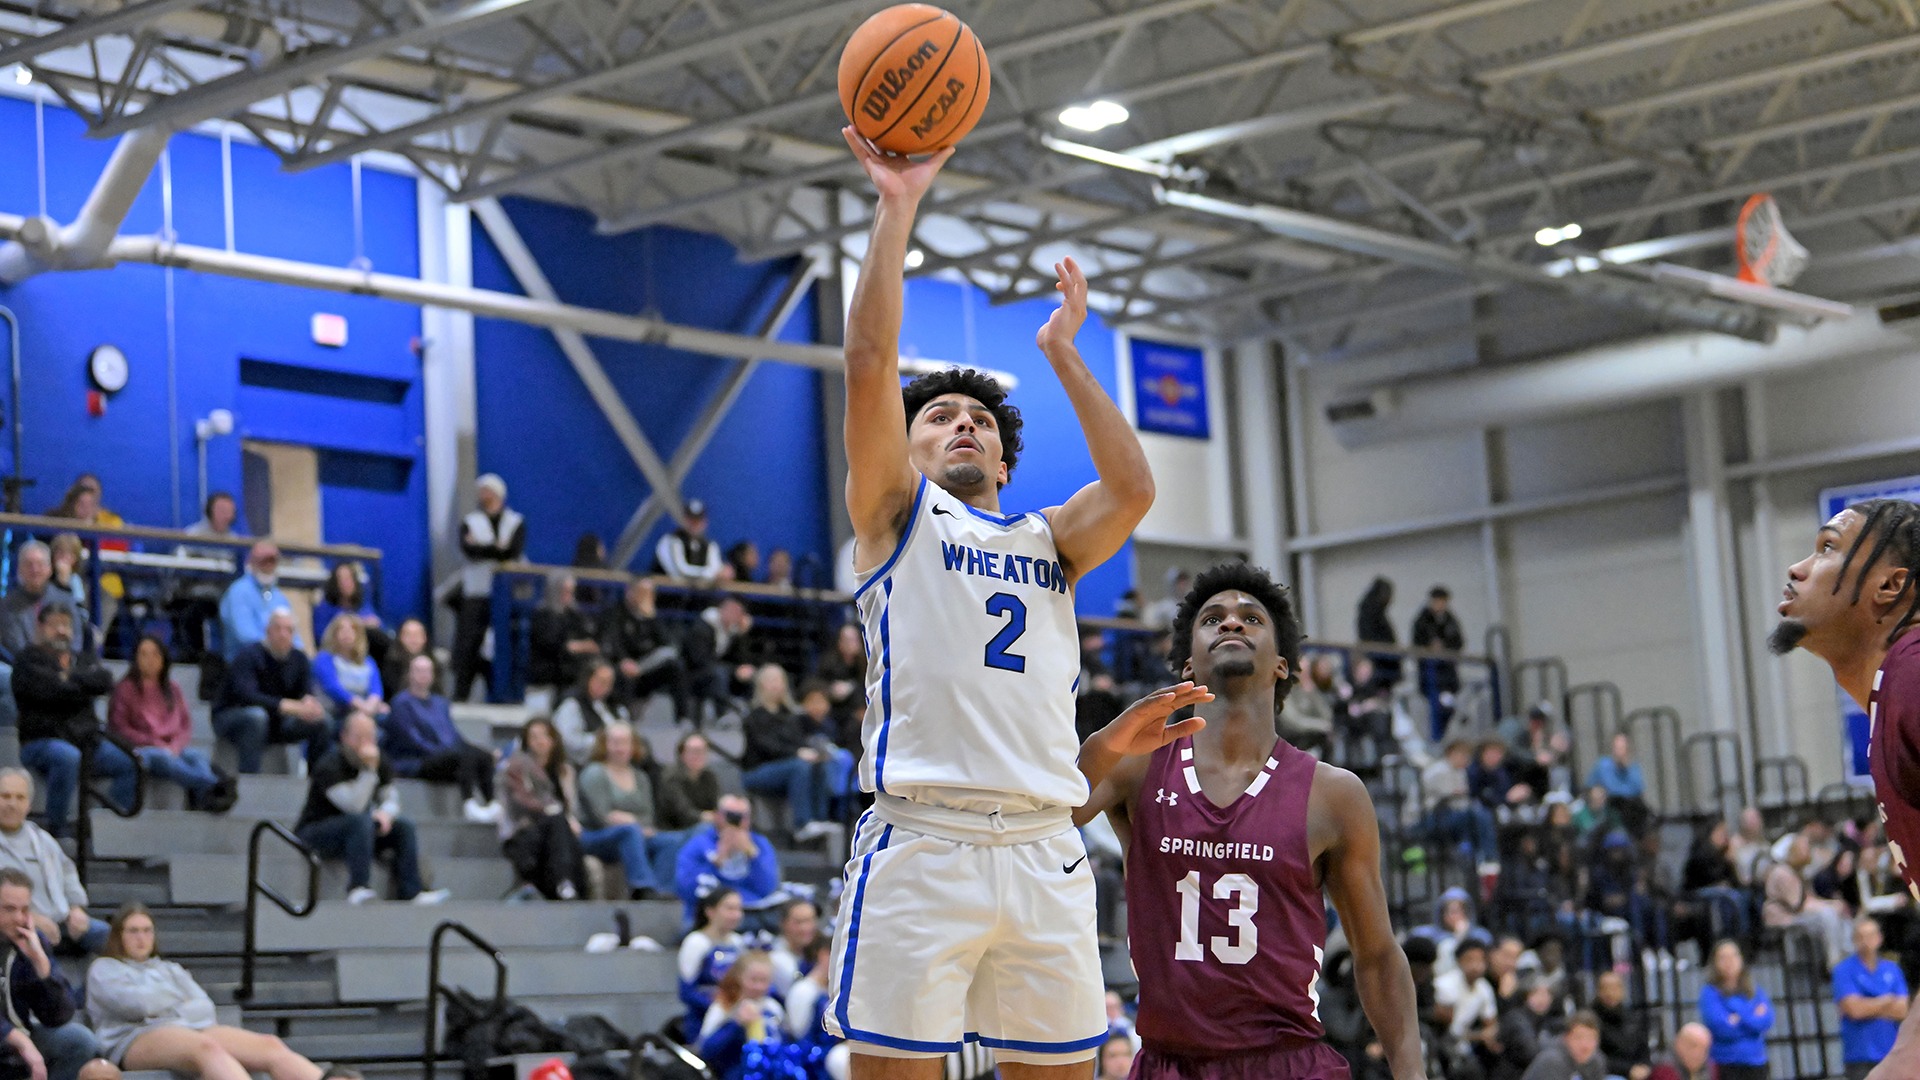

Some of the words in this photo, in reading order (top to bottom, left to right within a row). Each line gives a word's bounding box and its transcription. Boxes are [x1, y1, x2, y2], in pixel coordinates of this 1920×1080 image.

[862, 40, 939, 121] Wilson
[910, 78, 965, 139] NCAA
[941, 540, 1068, 595] WHEATON
[984, 592, 1028, 674] 2
[1159, 836, 1275, 862] SPRINGFIELD
[1174, 870, 1260, 965] 13
